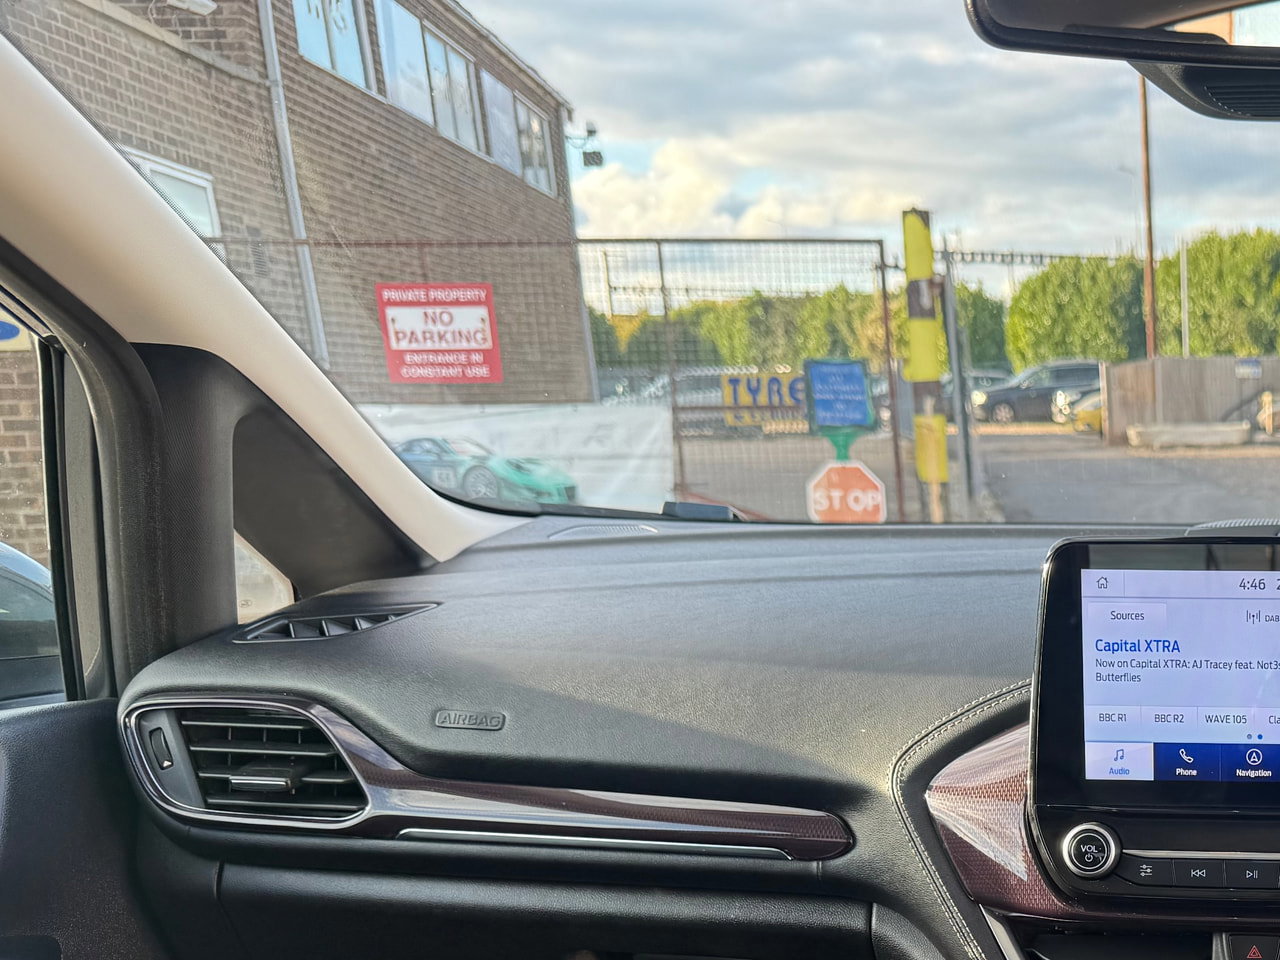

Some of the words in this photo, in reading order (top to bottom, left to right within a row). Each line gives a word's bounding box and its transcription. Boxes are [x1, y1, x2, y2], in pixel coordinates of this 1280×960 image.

[382, 288, 427, 302] PRIVATE
[428, 288, 487, 302] PROPERTY
[423, 310, 454, 327] NO
[394, 329, 488, 345] PARKING
[404, 352, 468, 364] ENTRANCE
[470, 352, 484, 364] IN
[400, 365, 463, 378] CONSTANT
[465, 365, 490, 378] USE
[813, 488, 882, 511] STOP
[1239, 578, 1266, 591] 4:46
[1110, 610, 1145, 621] Sources
[1264, 614, 1280, 623] DAB
[1095, 638, 1141, 654] Capital
[1144, 639, 1181, 653] XTRA
[1095, 658, 1115, 668] Now
[1117, 660, 1128, 668] on
[1130, 658, 1161, 670] Capital
[1163, 659, 1190, 669] XTRA:
[1192, 659, 1203, 669] AJ
[1204, 659, 1233, 671] Tracey
[1234, 659, 1255, 670] feat.
[1095, 672, 1142, 683] Butterflies
[440, 713, 501, 728] AIRBAG
[1098, 713, 1115, 722] BBC
[1117, 713, 1127, 722] R1
[1154, 714, 1171, 723] BBC
[1173, 714, 1184, 723] R2
[1204, 715, 1231, 724] WAVE
[1232, 715, 1247, 724] 105
[1108, 767, 1130, 776] Audio
[1175, 768, 1197, 776] Phone
[1236, 768, 1272, 778] Navigation
[1080, 844, 1098, 854] VOL
